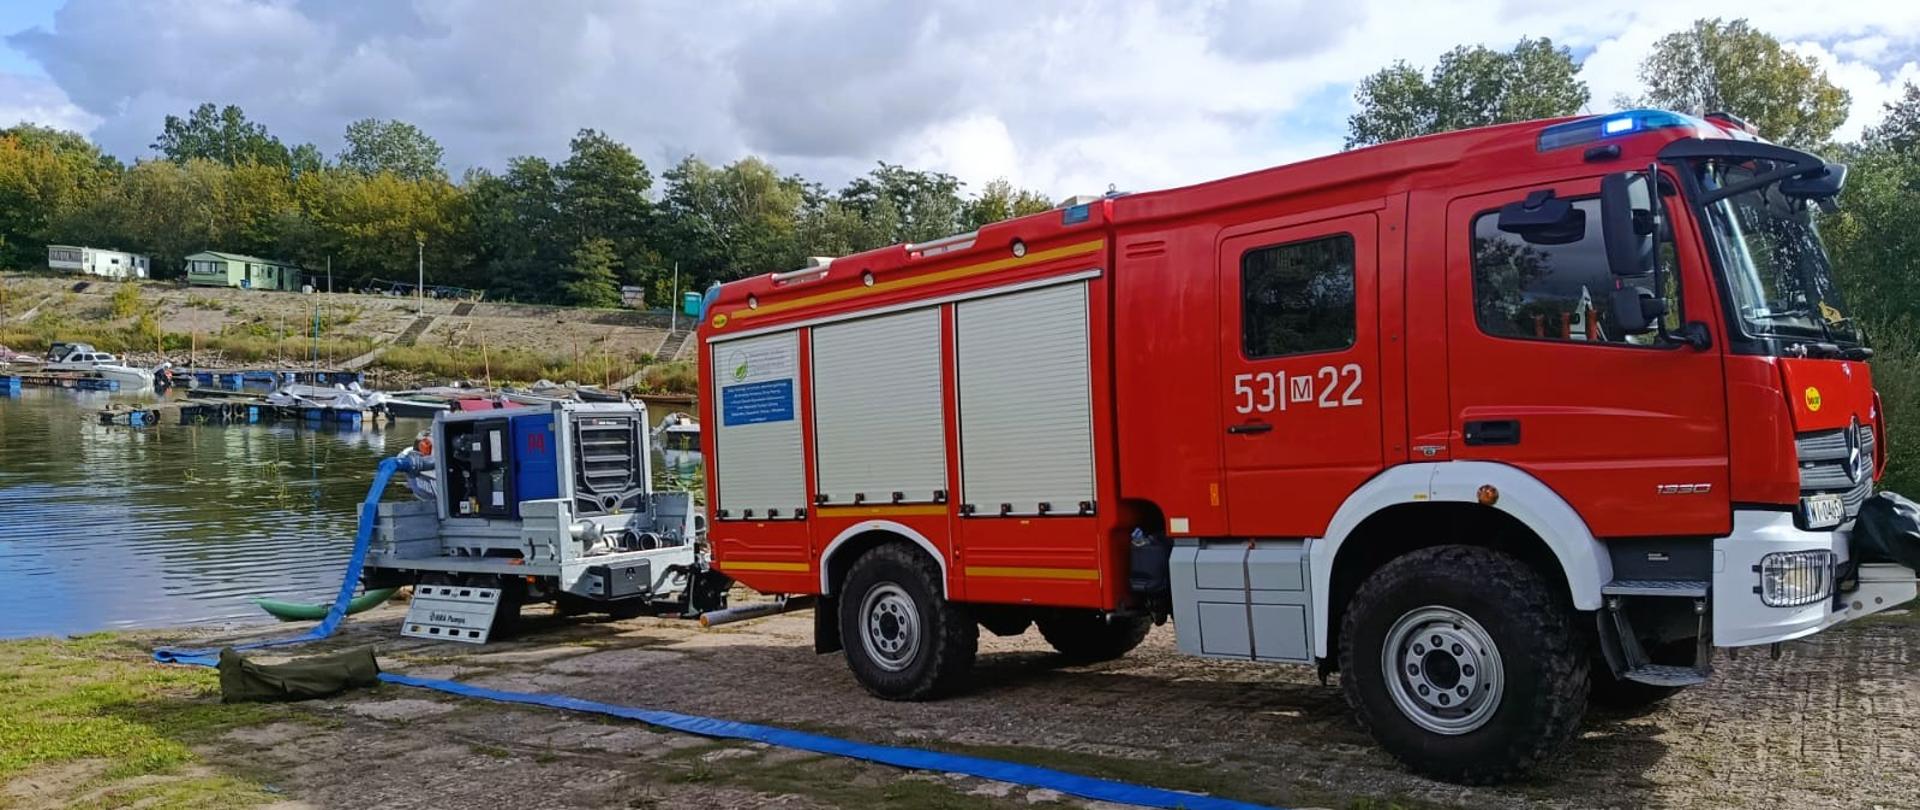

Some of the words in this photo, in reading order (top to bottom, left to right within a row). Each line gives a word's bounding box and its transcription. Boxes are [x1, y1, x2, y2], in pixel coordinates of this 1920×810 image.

[1235, 371, 1286, 413] 531
[1293, 378, 1311, 401] M
[1318, 363, 1363, 408] 22
